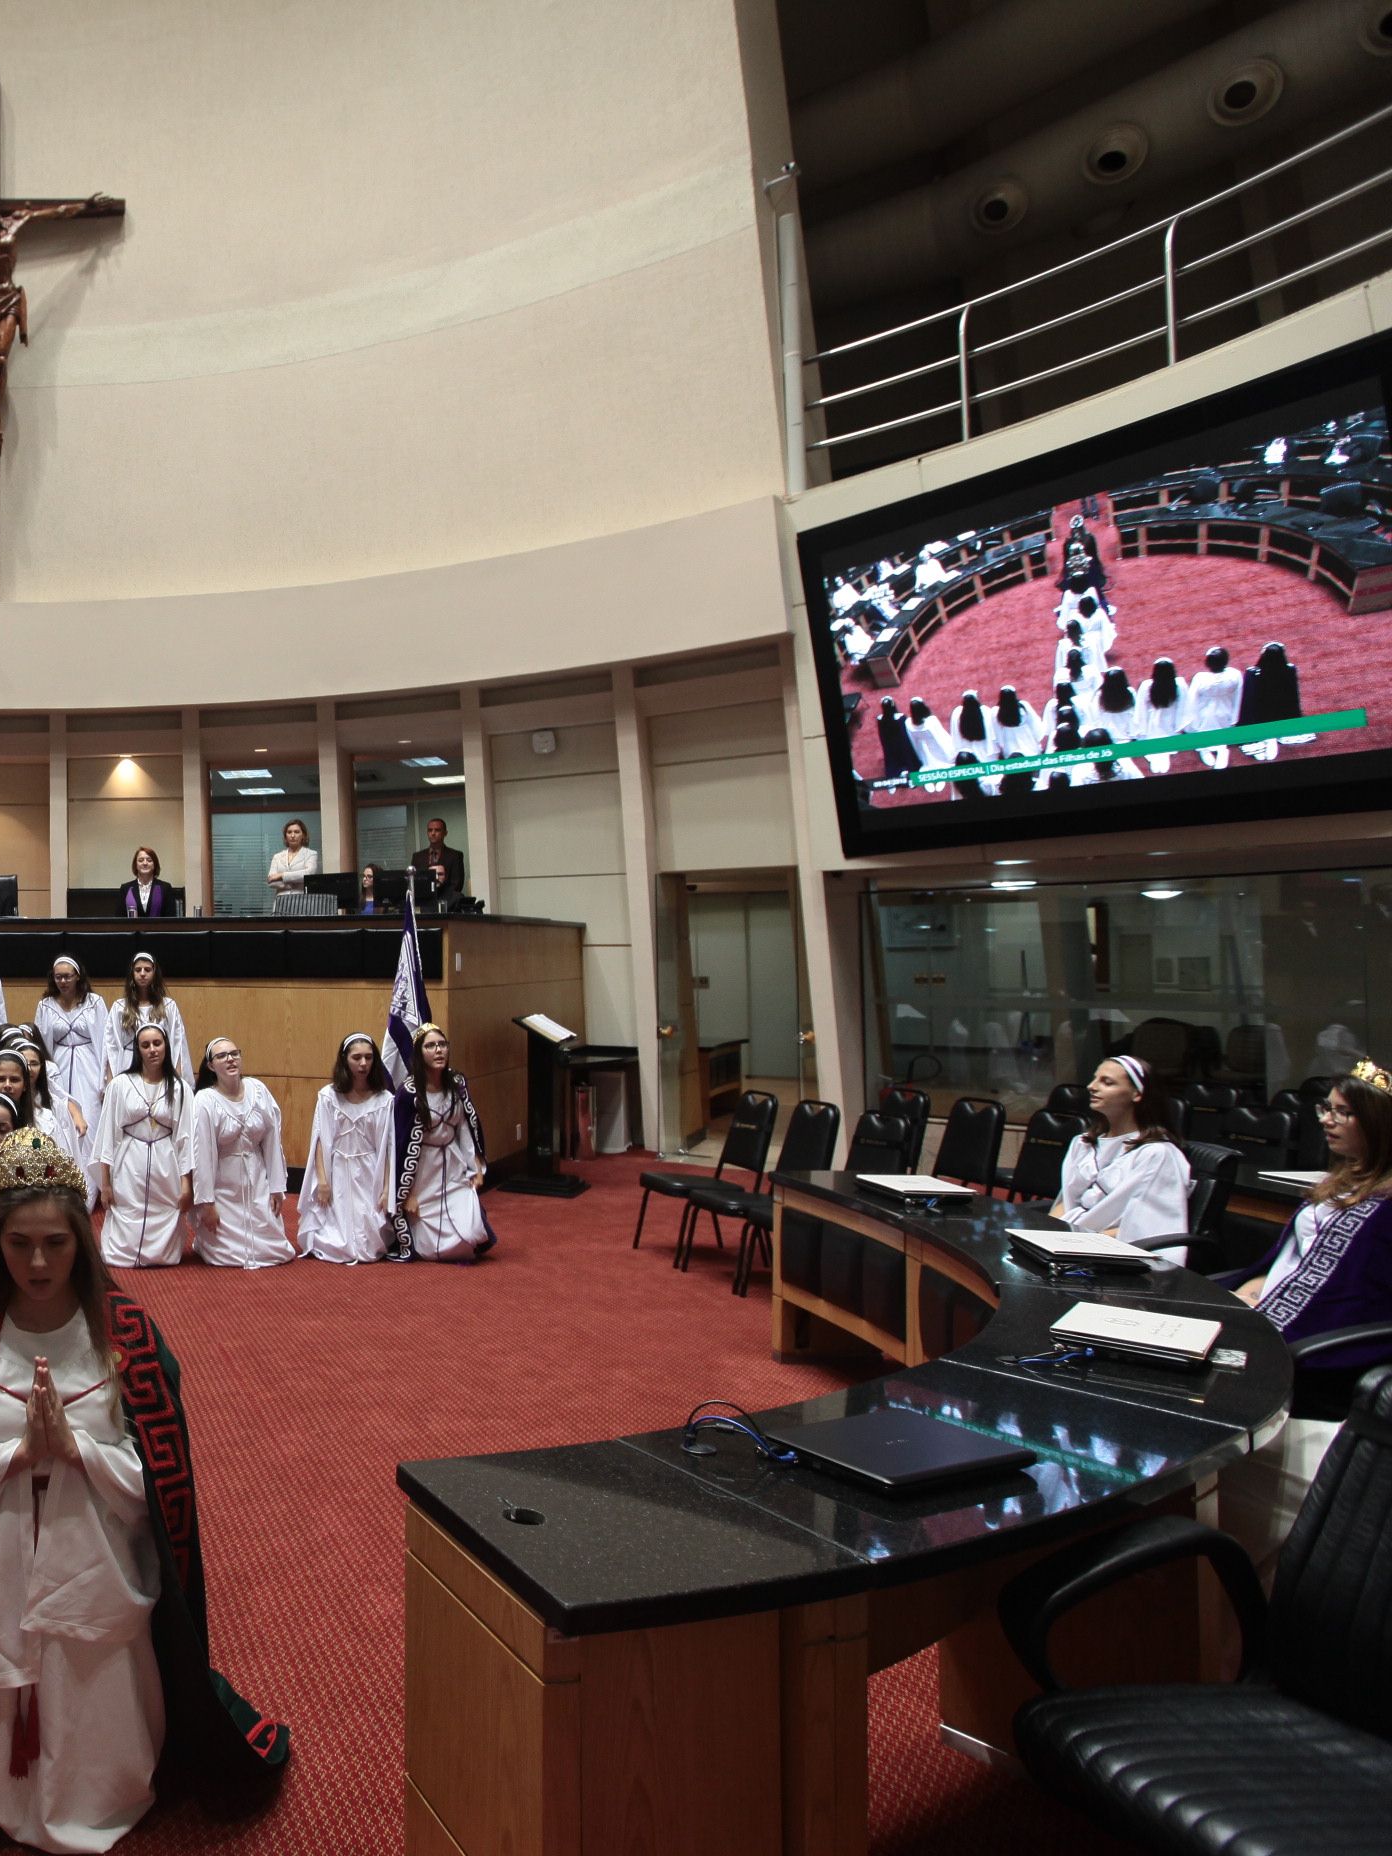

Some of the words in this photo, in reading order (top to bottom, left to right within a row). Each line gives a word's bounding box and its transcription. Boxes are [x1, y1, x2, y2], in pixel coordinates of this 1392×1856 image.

[918, 771, 948, 783] SESSÃO
[948, 767, 985, 779] ESPECIAL
[990, 763, 1005, 773] Dia
[1005, 758, 1042, 770] estadual
[1042, 756, 1058, 766] das
[1058, 754, 1086, 764] Filhas
[1086, 751, 1100, 760] de
